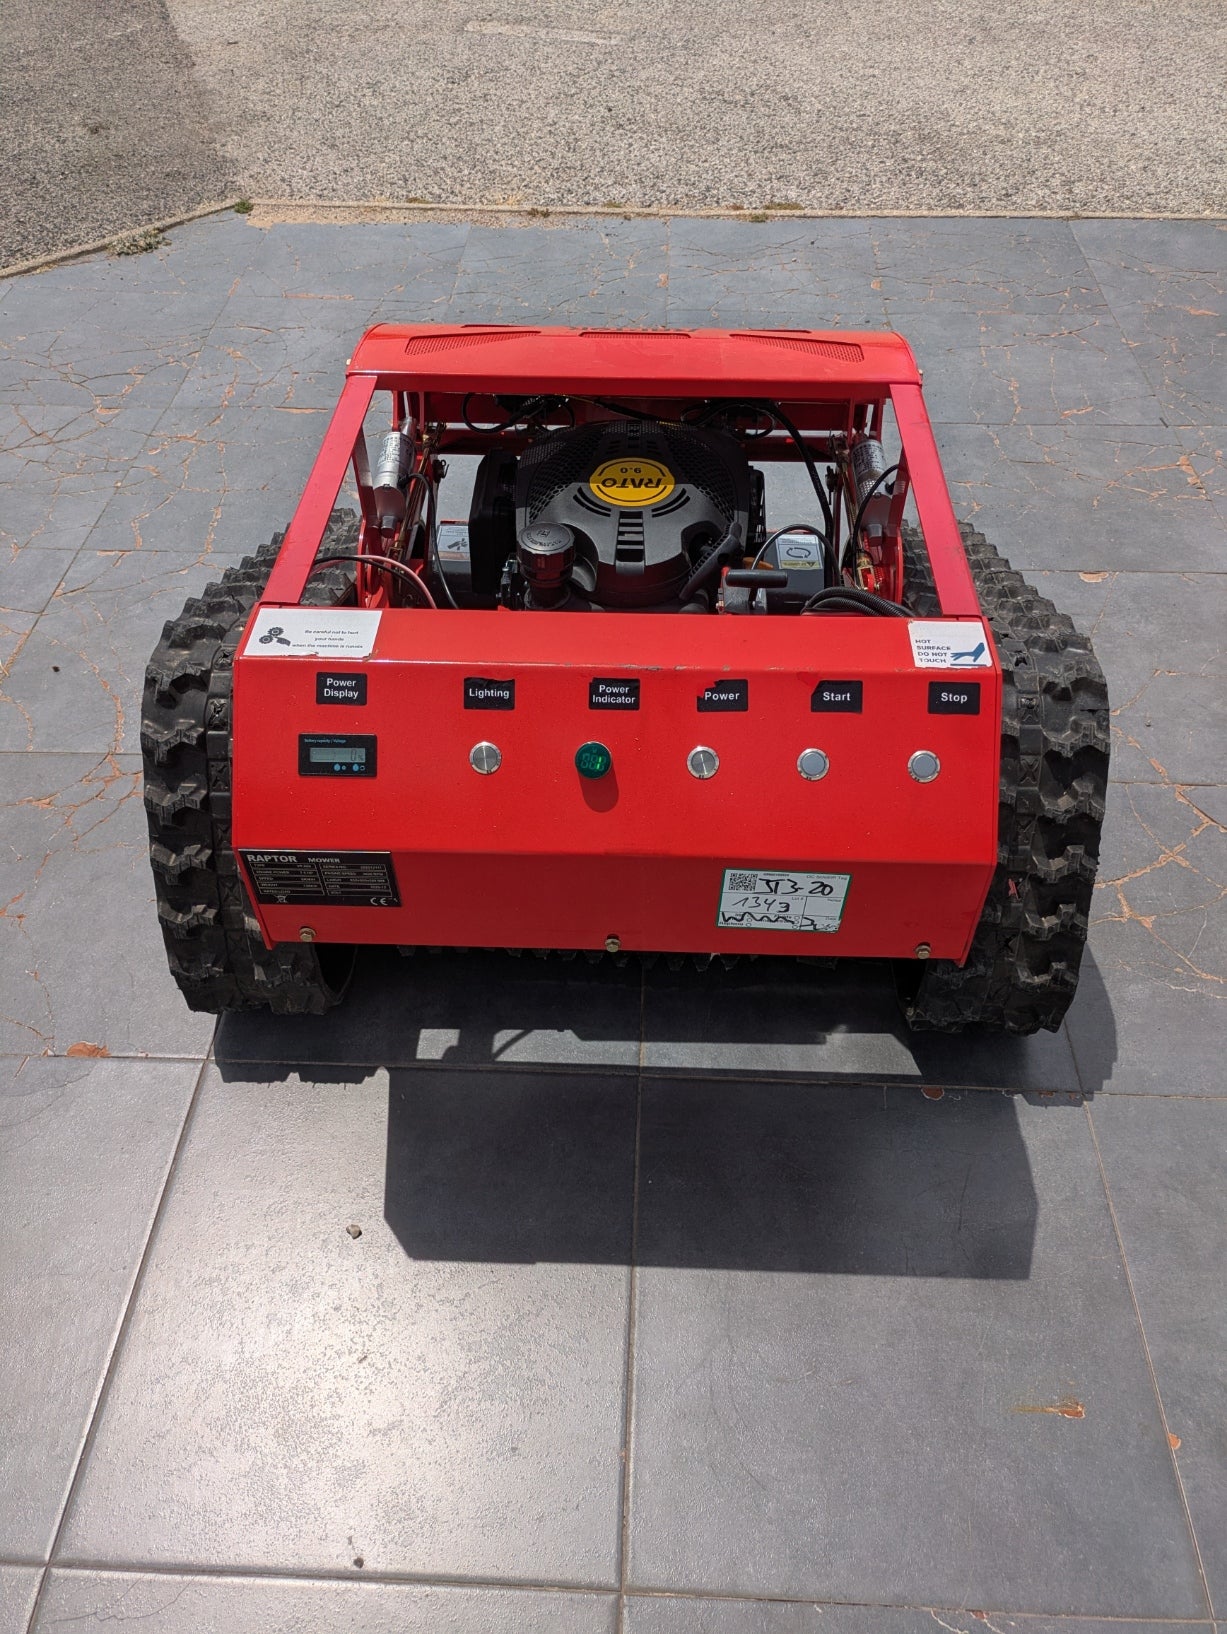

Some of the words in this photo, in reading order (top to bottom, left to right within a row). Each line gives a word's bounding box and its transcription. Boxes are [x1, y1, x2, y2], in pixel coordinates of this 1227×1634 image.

[601, 477, 663, 488] RATO
[326, 678, 356, 687] Power
[469, 687, 510, 699] Lighting
[599, 684, 629, 693] Power
[323, 688, 359, 700] Display
[705, 691, 740, 700] Power
[823, 692, 851, 701] Start
[941, 692, 968, 704] Stop
[592, 695, 636, 704] Indicator
[246, 854, 298, 863] RAPTOR
